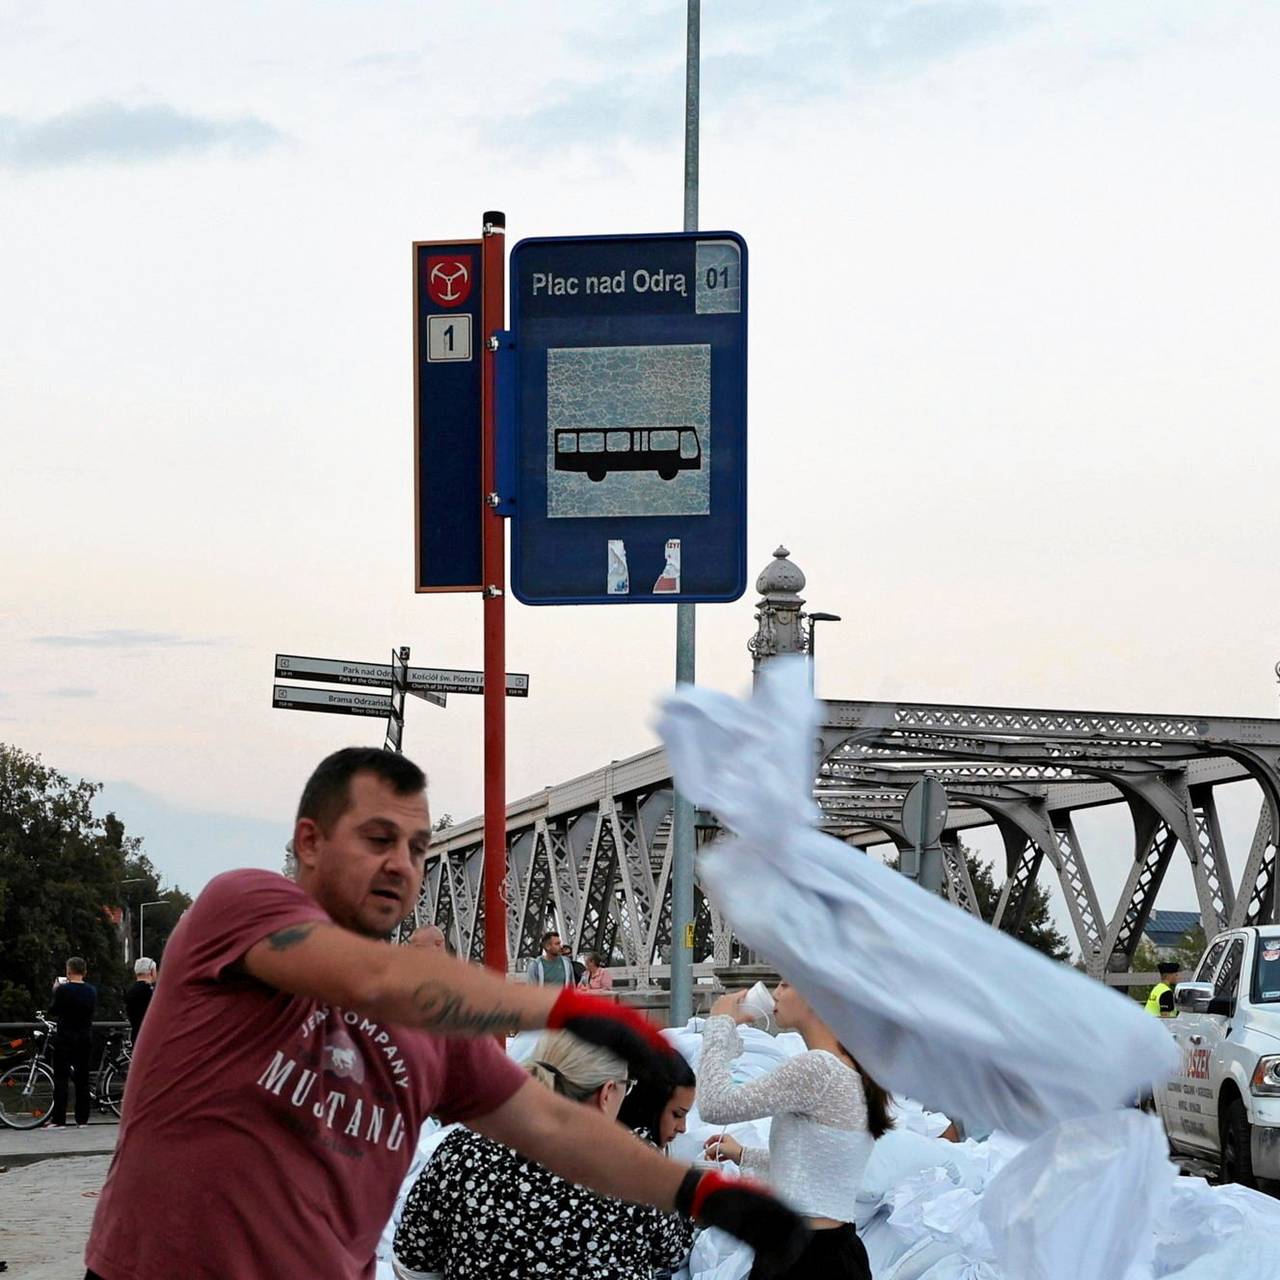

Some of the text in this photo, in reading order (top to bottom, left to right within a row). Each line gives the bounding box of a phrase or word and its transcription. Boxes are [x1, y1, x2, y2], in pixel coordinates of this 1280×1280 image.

[532, 268, 688, 297] Plac nad Odrą
[704, 266, 730, 290] 01
[443, 323, 455, 352] 1
[342, 666, 360, 675] Park
[361, 667, 375, 676] nad
[411, 672, 439, 682] Kościół
[453, 675, 476, 684] Piotra
[328, 695, 353, 704] Brama
[336, 1006, 410, 1089] OMPANY
